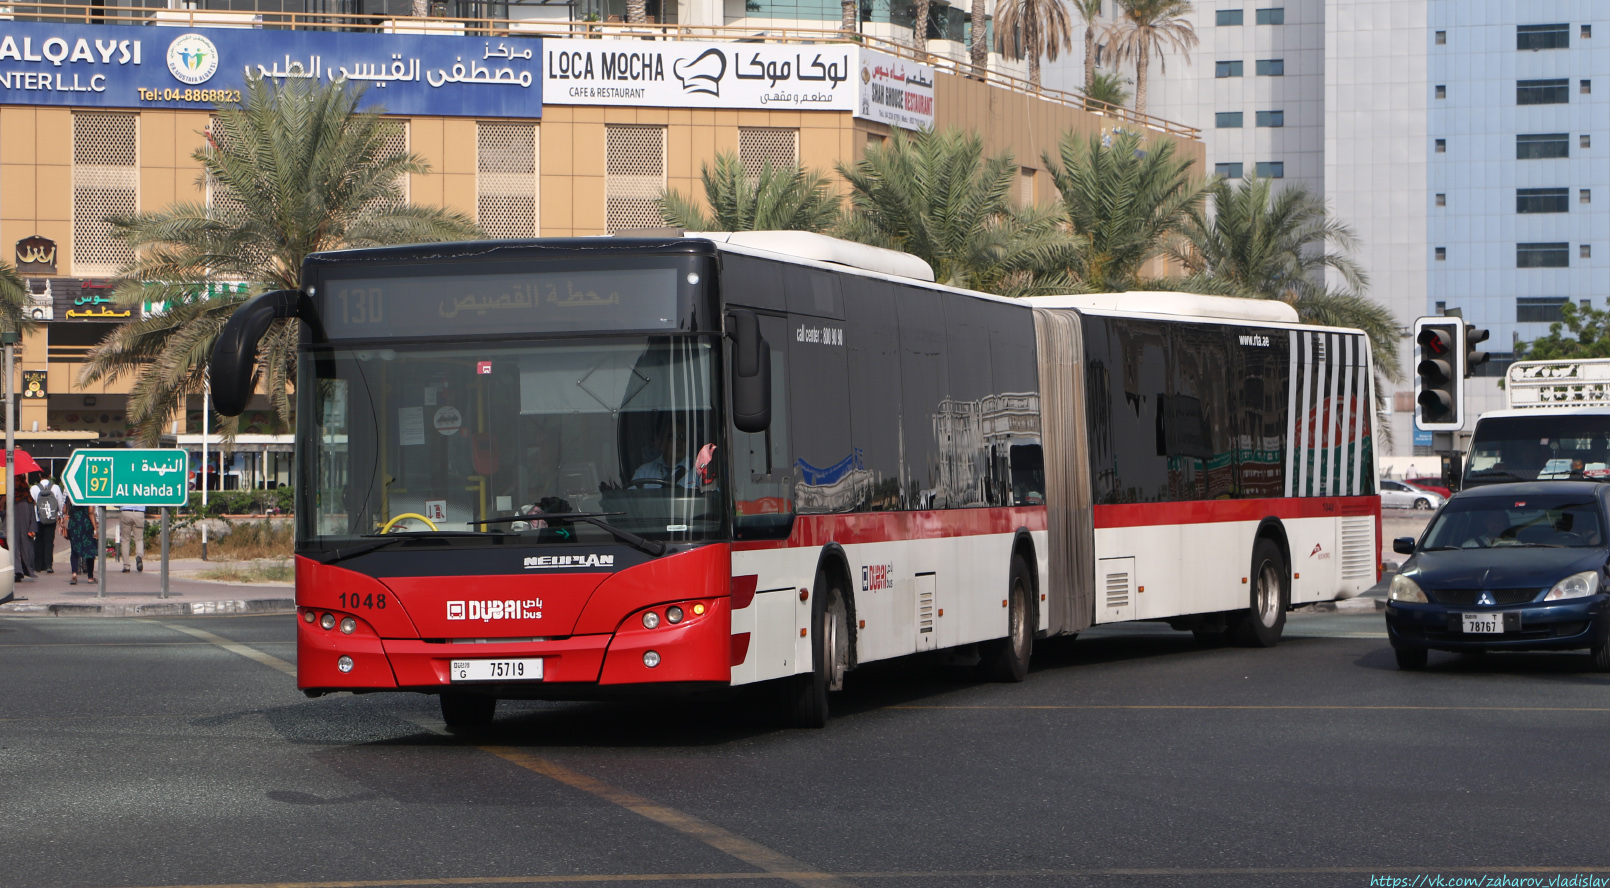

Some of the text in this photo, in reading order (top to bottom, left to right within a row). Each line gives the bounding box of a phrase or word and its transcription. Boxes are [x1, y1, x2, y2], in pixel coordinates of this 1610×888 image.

[0, 36, 140, 66] ALQAYSI
[483, 42, 532, 60] مركز
[426, 56, 532, 87] مصطفى
[549, 50, 664, 81] LOCA MOCHA
[735, 52, 848, 90] لوكا موكا
[890, 62, 905, 82] شاه
[56, 73, 106, 92] L.L.C
[138, 88, 240, 102] Tel: 04-8868823
[569, 87, 645, 98] CAFE & RESTAURANT
[800, 92, 832, 104] مطعم
[904, 91, 932, 116] RESTAURANT
[438, 280, 620, 318] محطة القصيص
[66, 306, 131, 320] مطعم
[796, 324, 805, 342] call
[806, 326, 819, 343] center
[823, 327, 831, 345] 800
[1238, 334, 1269, 347] www.rta.ae
[92, 465, 98, 474] D
[142, 458, 182, 476] النهدة
[90, 478, 108, 492] 97
[116, 484, 181, 496] Al Nahda 1
[339, 592, 386, 610] 1048
[469, 600, 521, 622] DUBAI
[523, 610, 542, 619] bus
[1470, 622, 1496, 632] 78767
[460, 670, 467, 678] G
[490, 662, 524, 677] 75719
